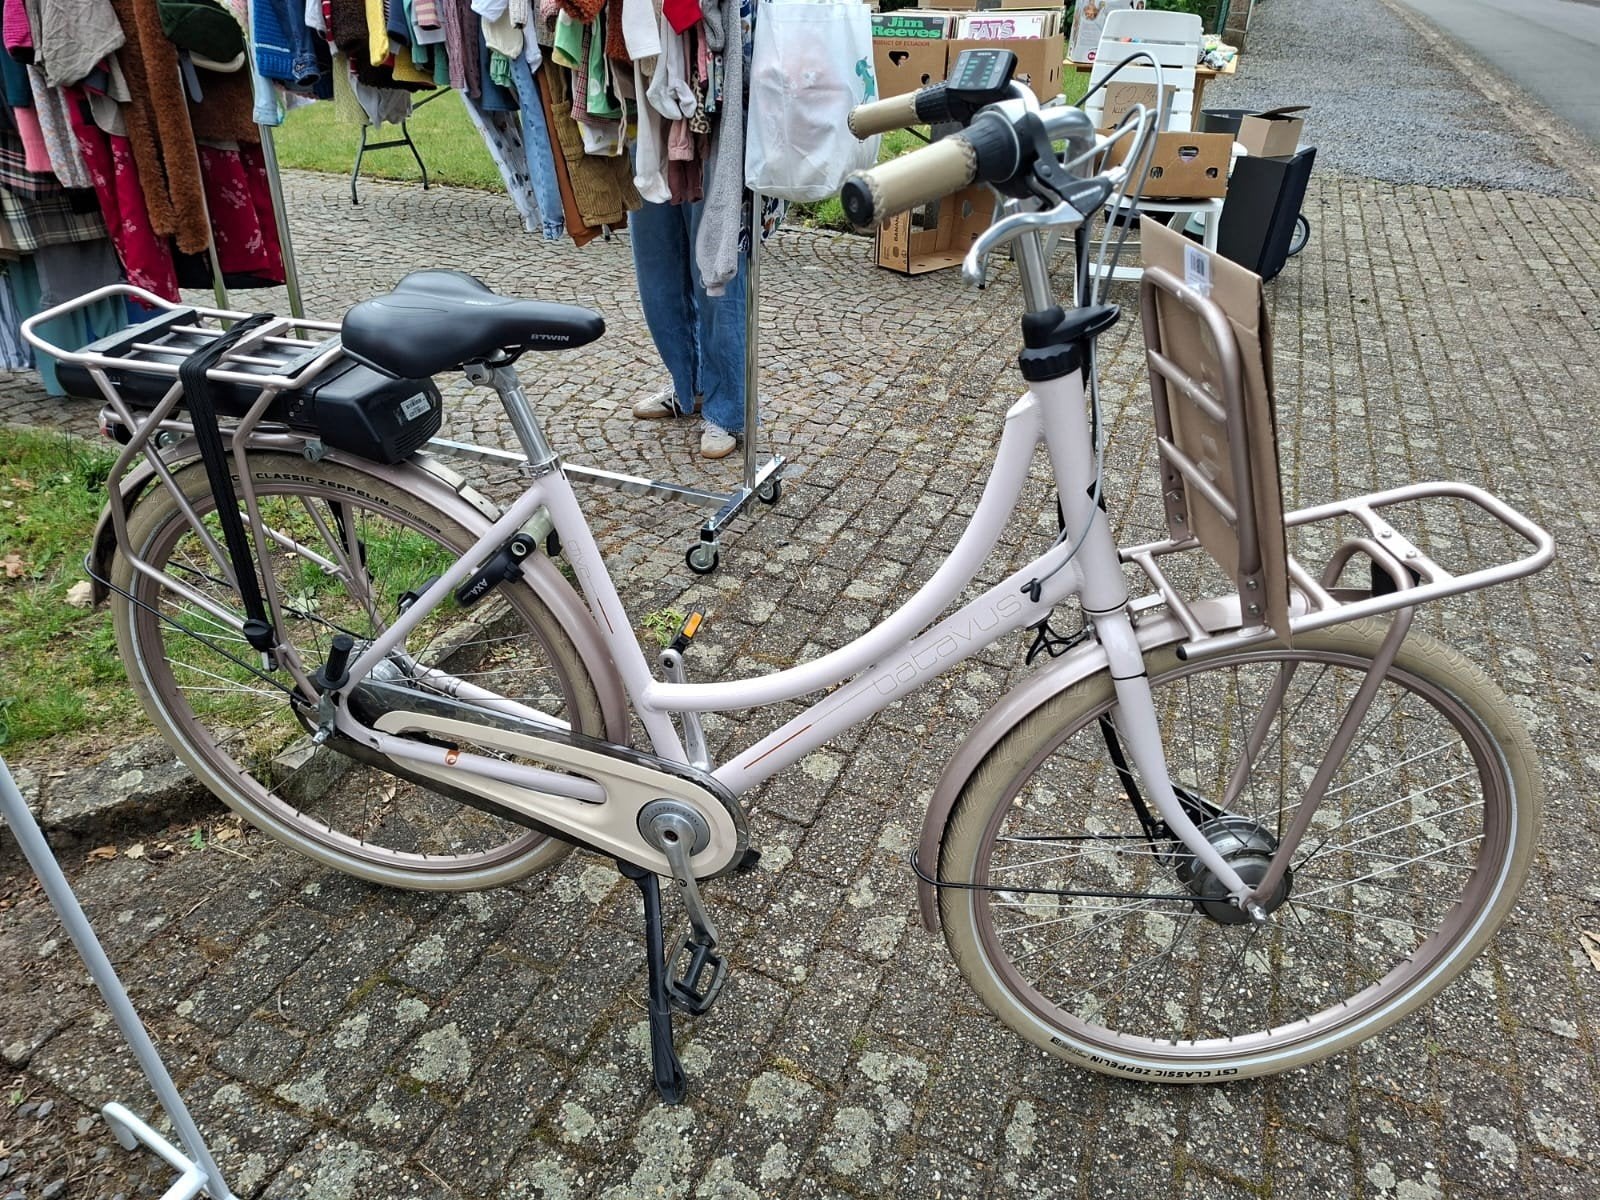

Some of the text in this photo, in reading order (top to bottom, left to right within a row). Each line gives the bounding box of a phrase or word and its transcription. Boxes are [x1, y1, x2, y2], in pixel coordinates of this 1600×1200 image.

[888, 16, 924, 28] Jim
[967, 20, 1016, 39] FATS
[872, 25, 941, 38] Reeves
[255, 472, 389, 506] CLASSIC ZEPPELIN
[470, 577, 488, 595] AXA
[1090, 1055, 1238, 1078] CST CLASSIC ZEPPELIN
